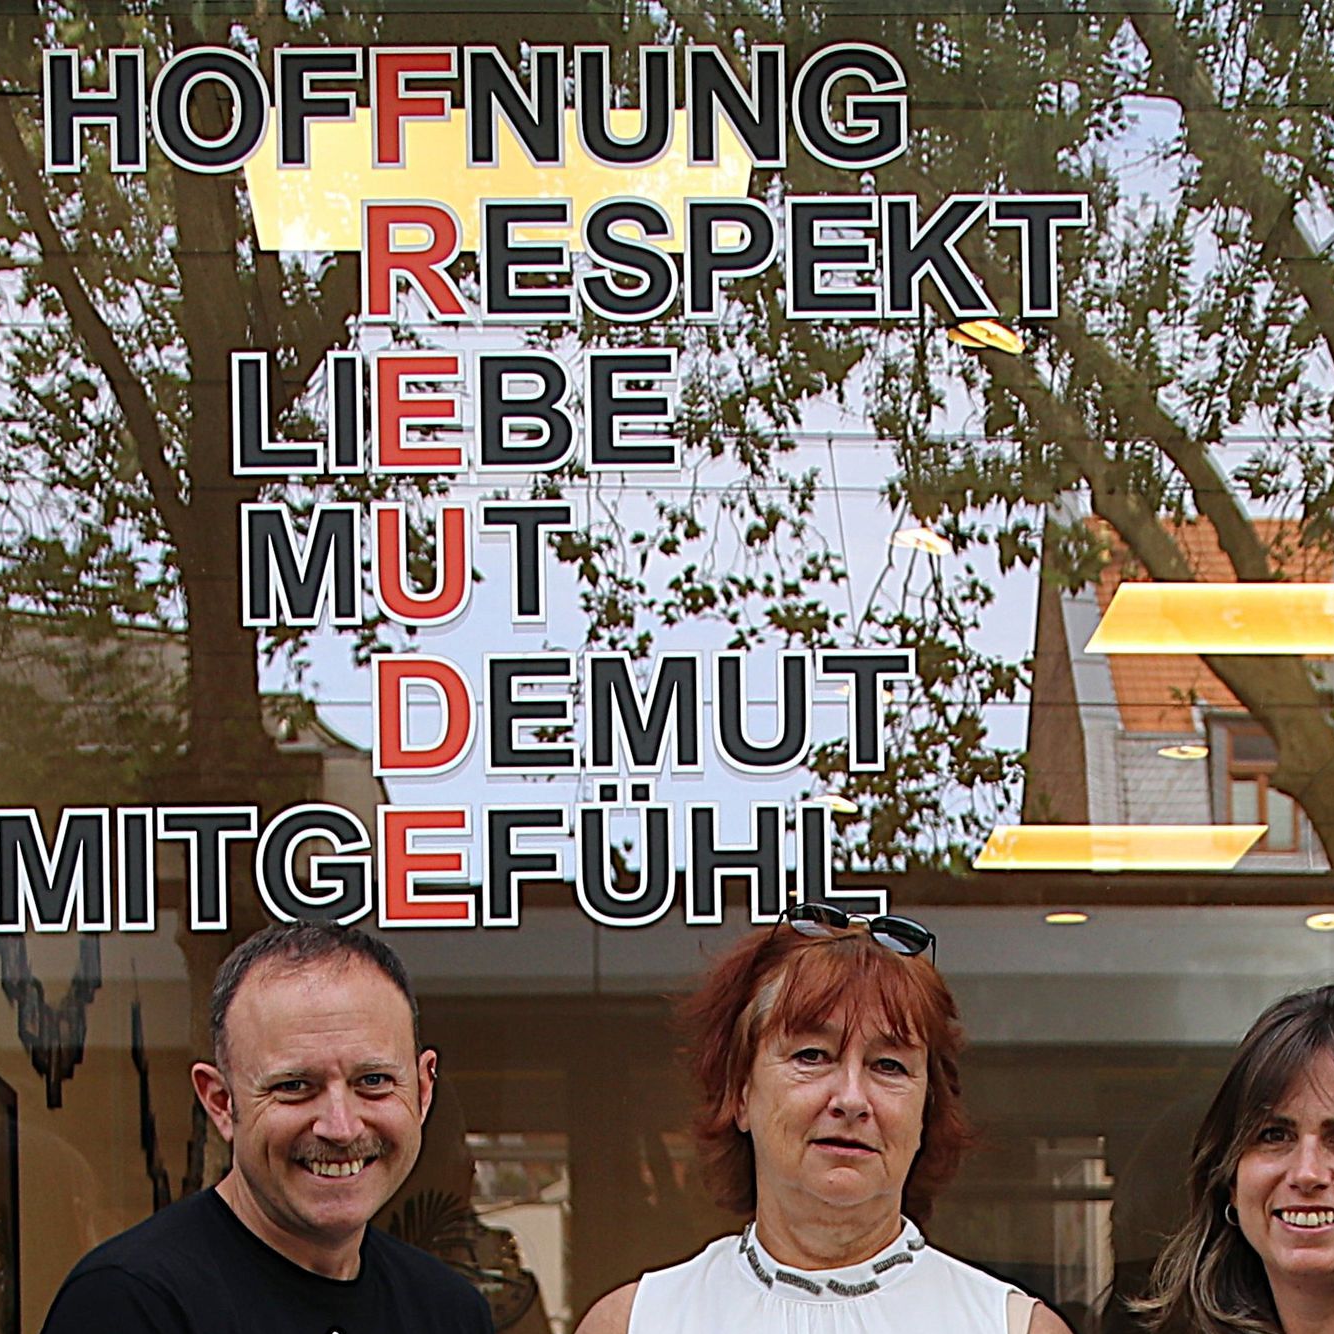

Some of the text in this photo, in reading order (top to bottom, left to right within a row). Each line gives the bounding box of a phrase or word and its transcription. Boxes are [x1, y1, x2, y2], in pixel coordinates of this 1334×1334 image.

[44, 42, 908, 175] HOFFNUNG
[361, 193, 1089, 323] RESPEKT
[230, 349, 681, 478] LIEBE
[239, 498, 572, 628] MUT
[371, 646, 916, 778] DEMUT
